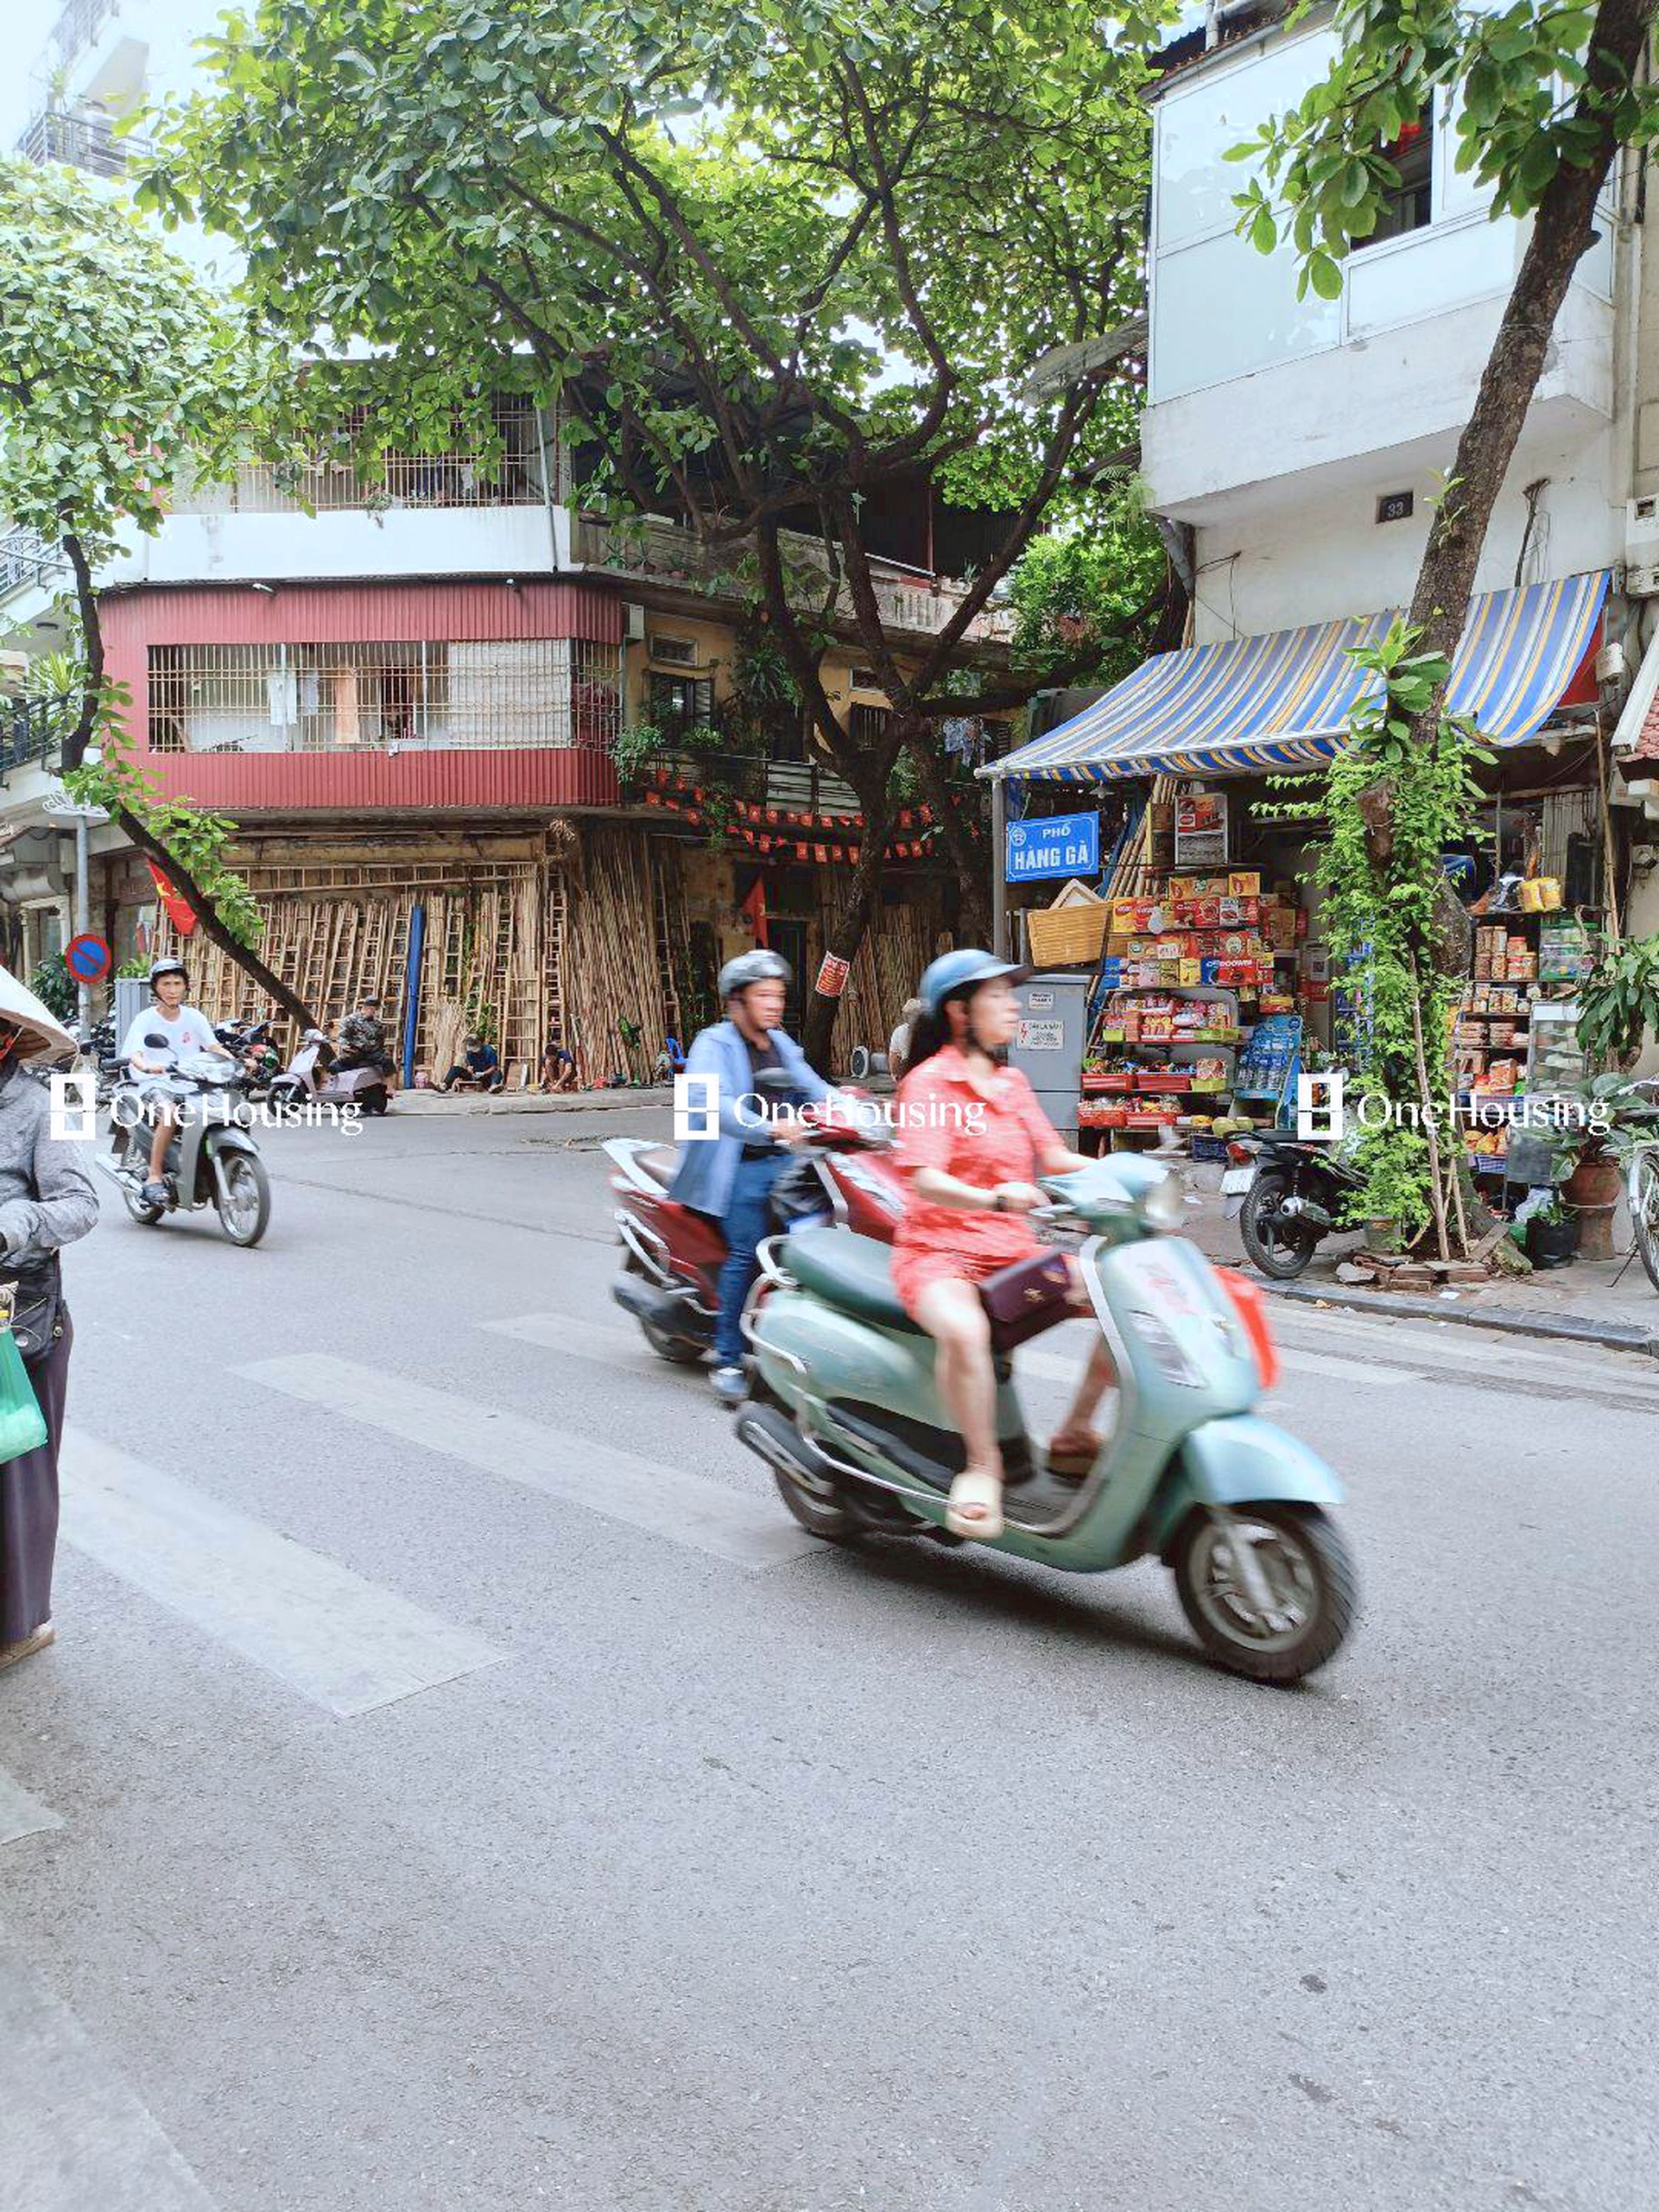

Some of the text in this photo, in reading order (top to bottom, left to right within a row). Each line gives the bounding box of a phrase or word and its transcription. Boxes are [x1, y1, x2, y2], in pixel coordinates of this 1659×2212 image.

[1042, 821, 1071, 839] PHỐ
[1015, 840, 1089, 870] HÀNG GÀ
